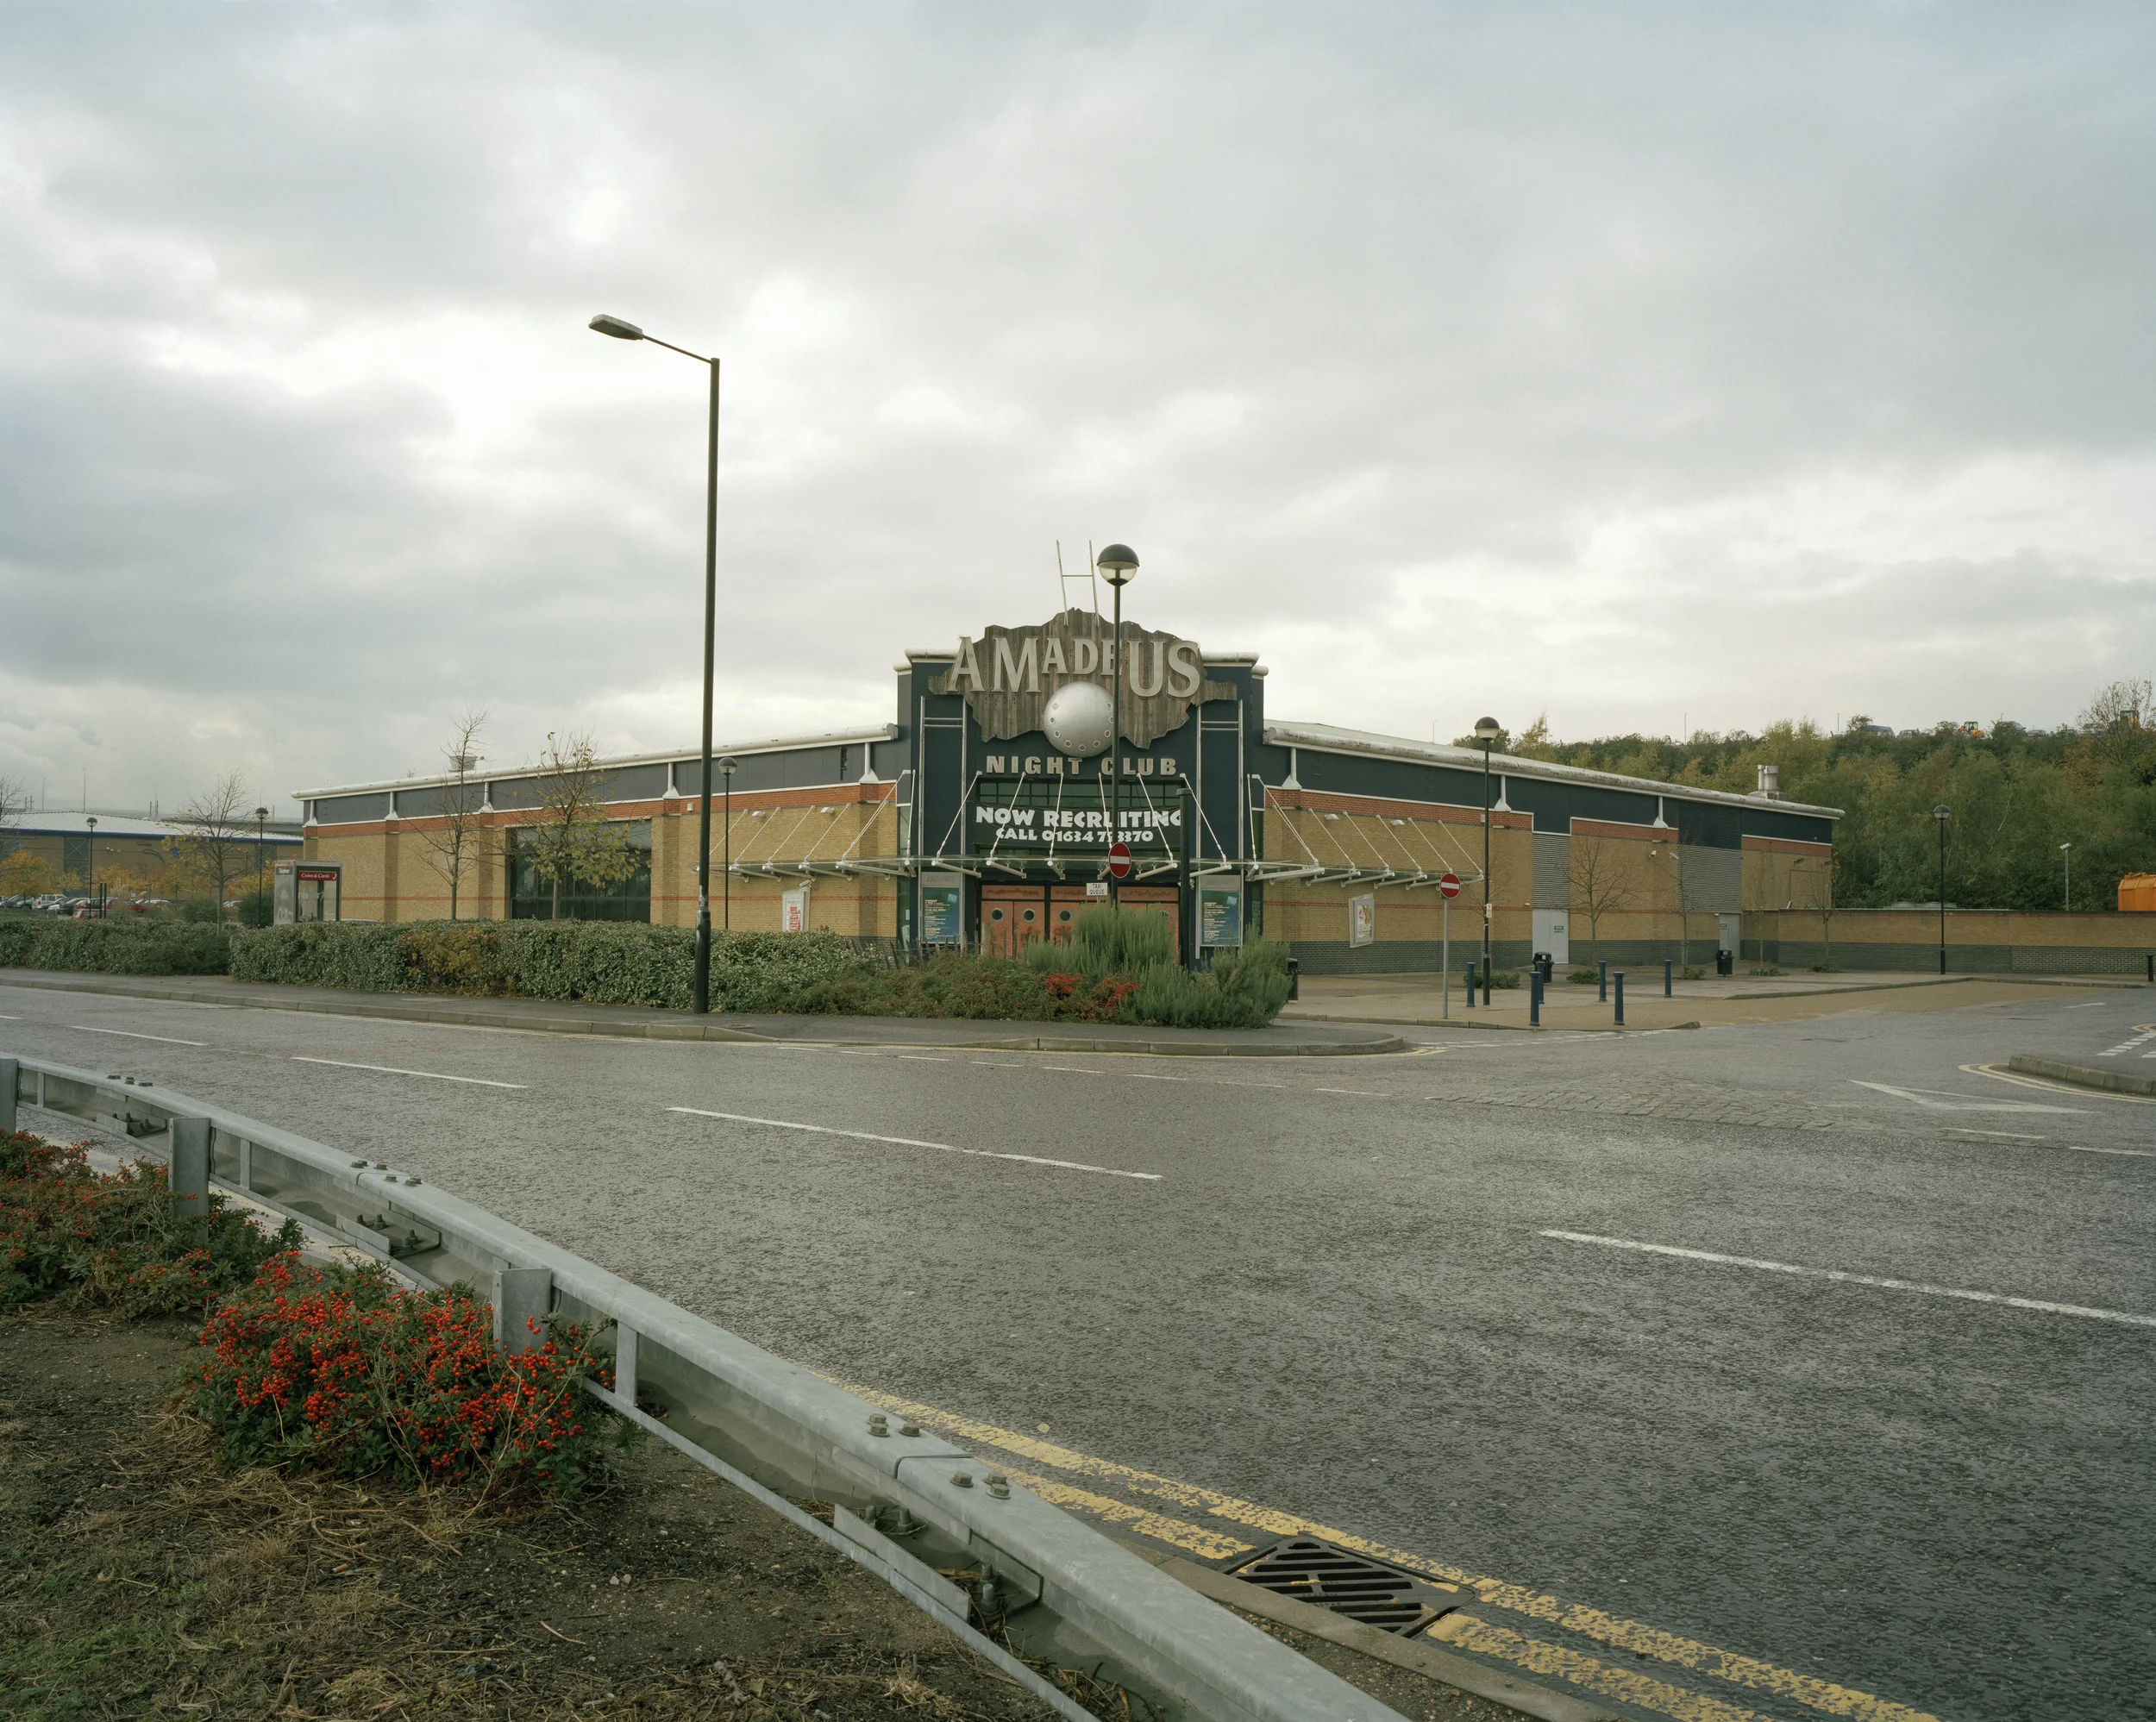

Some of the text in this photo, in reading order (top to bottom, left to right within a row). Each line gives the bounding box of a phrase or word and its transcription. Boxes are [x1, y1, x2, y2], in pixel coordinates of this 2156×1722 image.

[946, 636, 1201, 698] AMADEUS
[987, 755, 1176, 776] NIGHT CLUB
[976, 806, 1181, 828] NOW RECRUITING
[996, 828, 1037, 841] CALL
[1042, 830, 1094, 842] 01634
